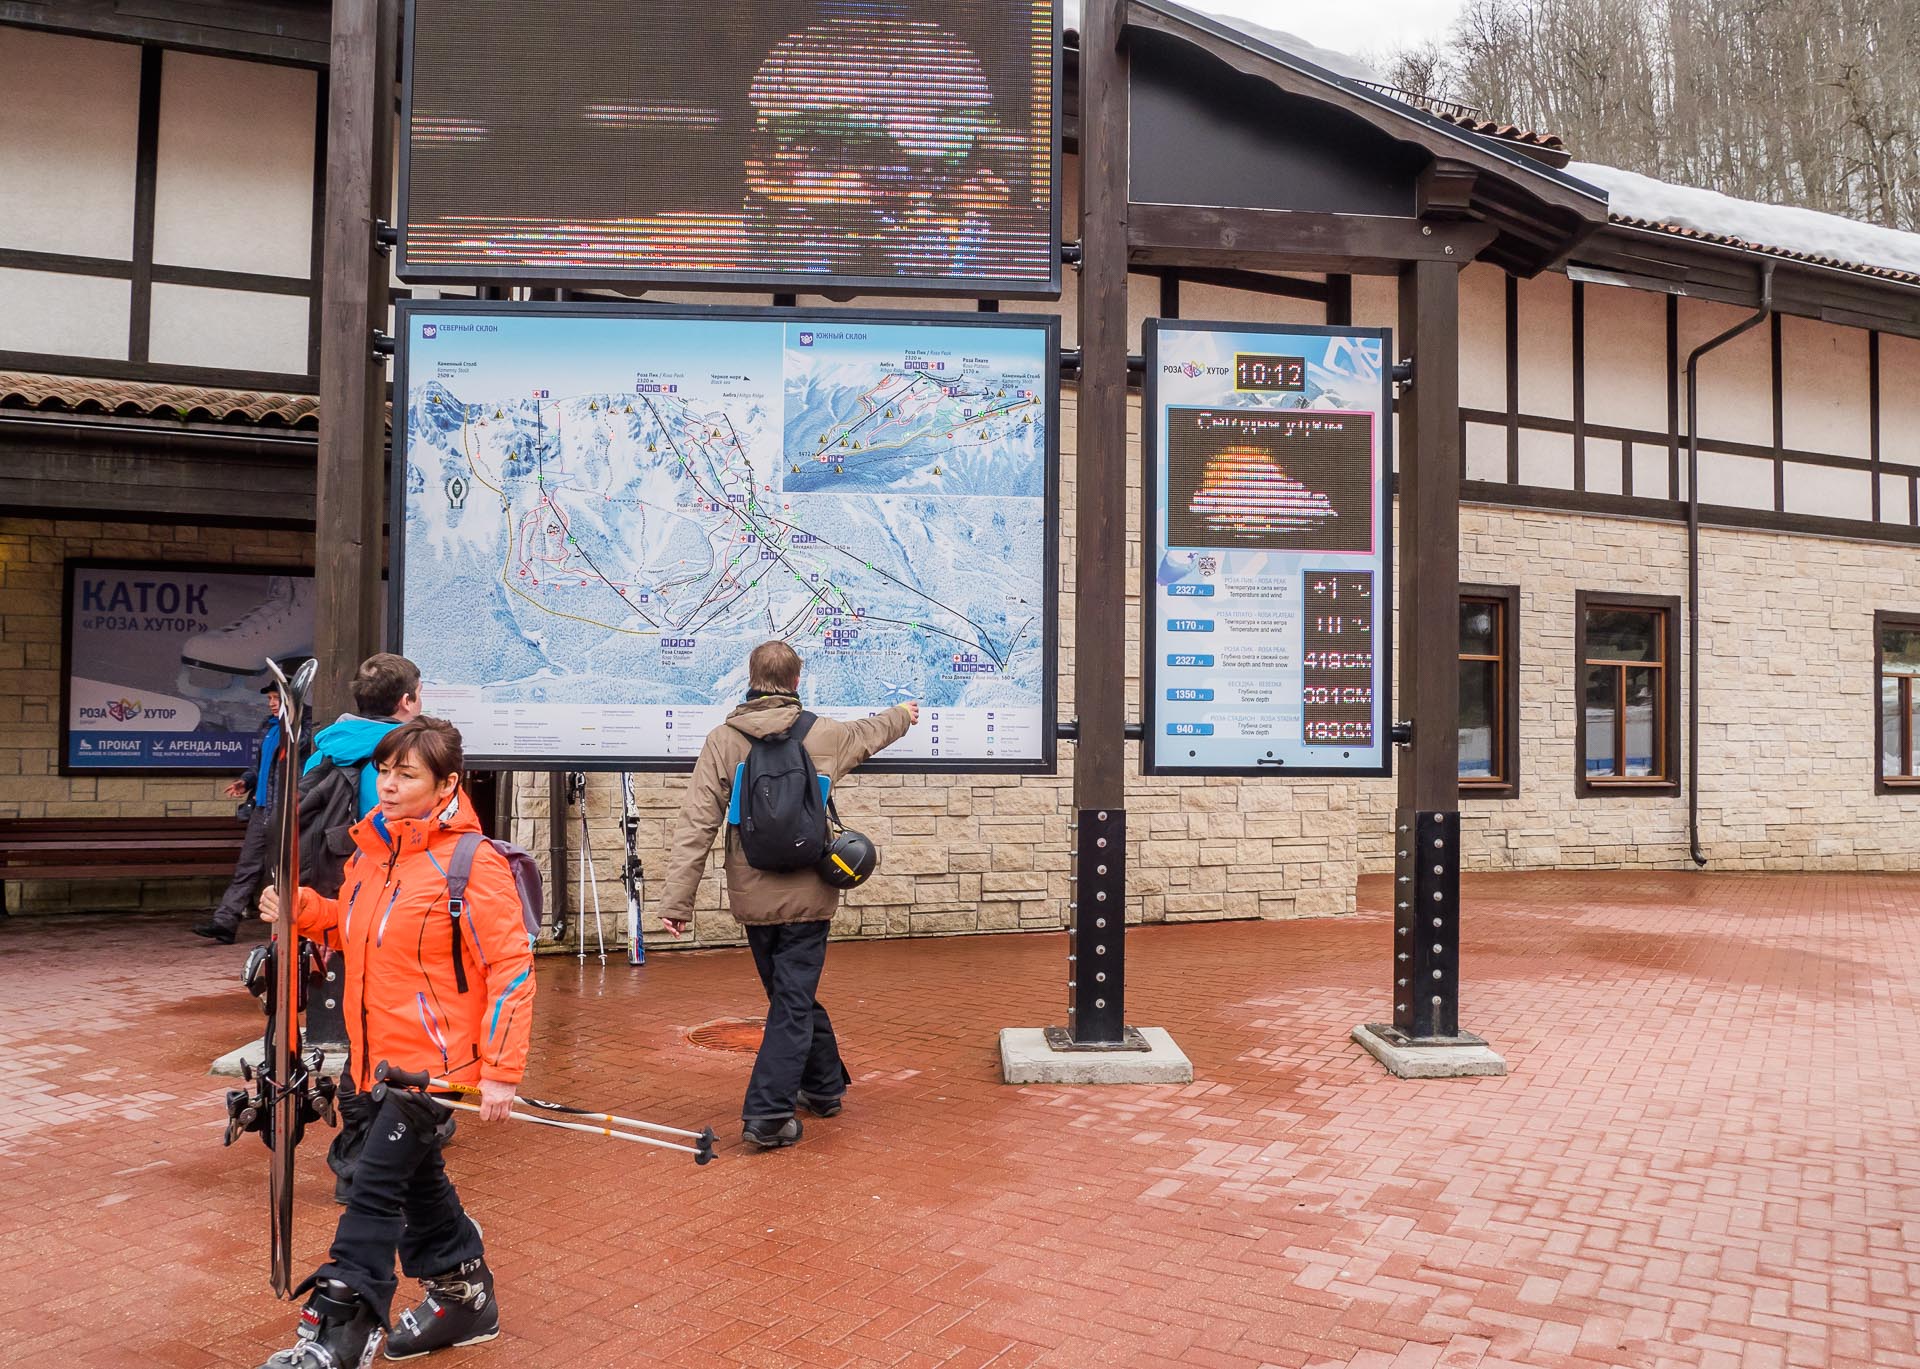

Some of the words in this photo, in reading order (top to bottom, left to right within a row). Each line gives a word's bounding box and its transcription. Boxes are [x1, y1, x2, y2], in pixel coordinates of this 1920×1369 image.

[816, 332, 843, 340] ЮЖНЫЙ
[1164, 365, 1182, 374] РОЗА
[1207, 366, 1229, 376] ХУТОР
[1239, 363, 1301, 385] 10:12
[1176, 586, 1196, 594] 2327
[82, 580, 208, 615] КАТОК
[82, 616, 138, 630] «РОЗА
[144, 618, 208, 632] ХУТОР»
[1176, 621, 1196, 629] 1170
[1176, 656, 1195, 665] 2327
[1176, 690, 1195, 699] 1350
[80, 708, 107, 718] РОЗА
[144, 709, 176, 719] ХУТОР
[1177, 724, 1193, 733] 940
[98, 741, 141, 750] ПРОКАТ
[169, 741, 212, 752] АРЕНДА
[214, 741, 242, 753] ЛЬДА
